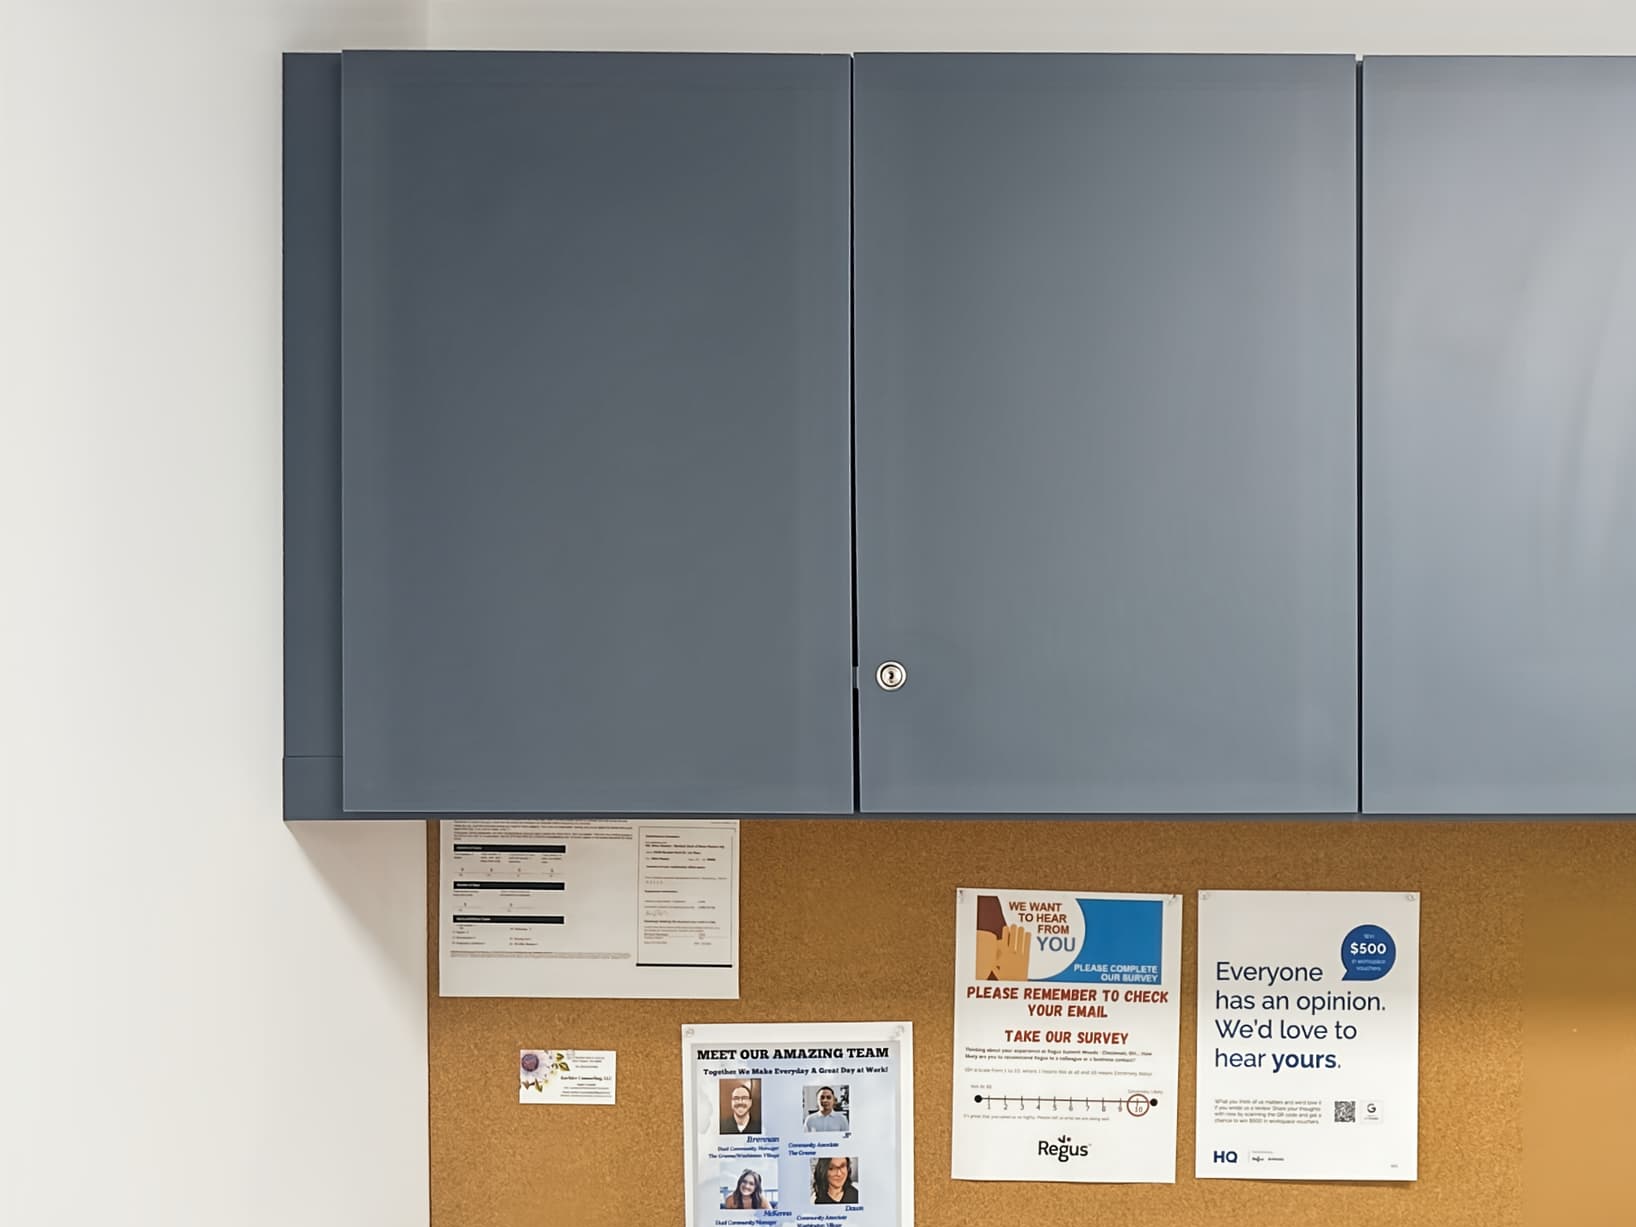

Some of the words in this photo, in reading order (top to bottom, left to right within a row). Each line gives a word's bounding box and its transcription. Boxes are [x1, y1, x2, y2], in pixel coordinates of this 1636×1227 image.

[1009, 901, 1027, 912] WE
[1028, 902, 1063, 913] WANT
[1018, 913, 1034, 923] TO
[1036, 913, 1067, 923] HEAR
[1037, 924, 1069, 934] FROM
[1036, 936, 1076, 952] YOU
[1350, 942, 1386, 955] $500
[1074, 964, 1108, 974] PLEASE
[1110, 964, 1158, 974] COMPLETE
[1217, 962, 1323, 986] Everyone
[1101, 973, 1120, 984] OUR
[1122, 974, 1158, 985] SURVEY
[967, 986, 1019, 999] PLEASE
[1024, 988, 1097, 1001] REMEMBER
[1102, 990, 1119, 1002] TO
[1124, 990, 1169, 1003] CHECK
[1216, 990, 1255, 1009] has
[1262, 995, 1289, 1010] an
[1296, 991, 1385, 1015] opinion.
[1028, 1004, 1063, 1016] YOUR
[1067, 1005, 1108, 1018] EMAIL
[1215, 1019, 1272, 1039] We'd
[1280, 1019, 1328, 1039] love
[1334, 1020, 1357, 1040] to
[1005, 1030, 1041, 1042] TAKE
[1045, 1031, 1072, 1043] OUR
[1077, 1032, 1128, 1044] SURVEY
[697, 1050, 737, 1060] MEET
[740, 1049, 770, 1059] OUR
[772, 1048, 843, 1059] AMAZING
[846, 1048, 889, 1058] TEAM
[1215, 1048, 1266, 1067] hear
[1271, 1053, 1341, 1073] yours.
[703, 1068, 736, 1076] Together
[774, 1067, 809, 1076] Everyday
[1038, 1140, 1088, 1162] Regus
[1213, 1150, 1238, 1163] HQ
